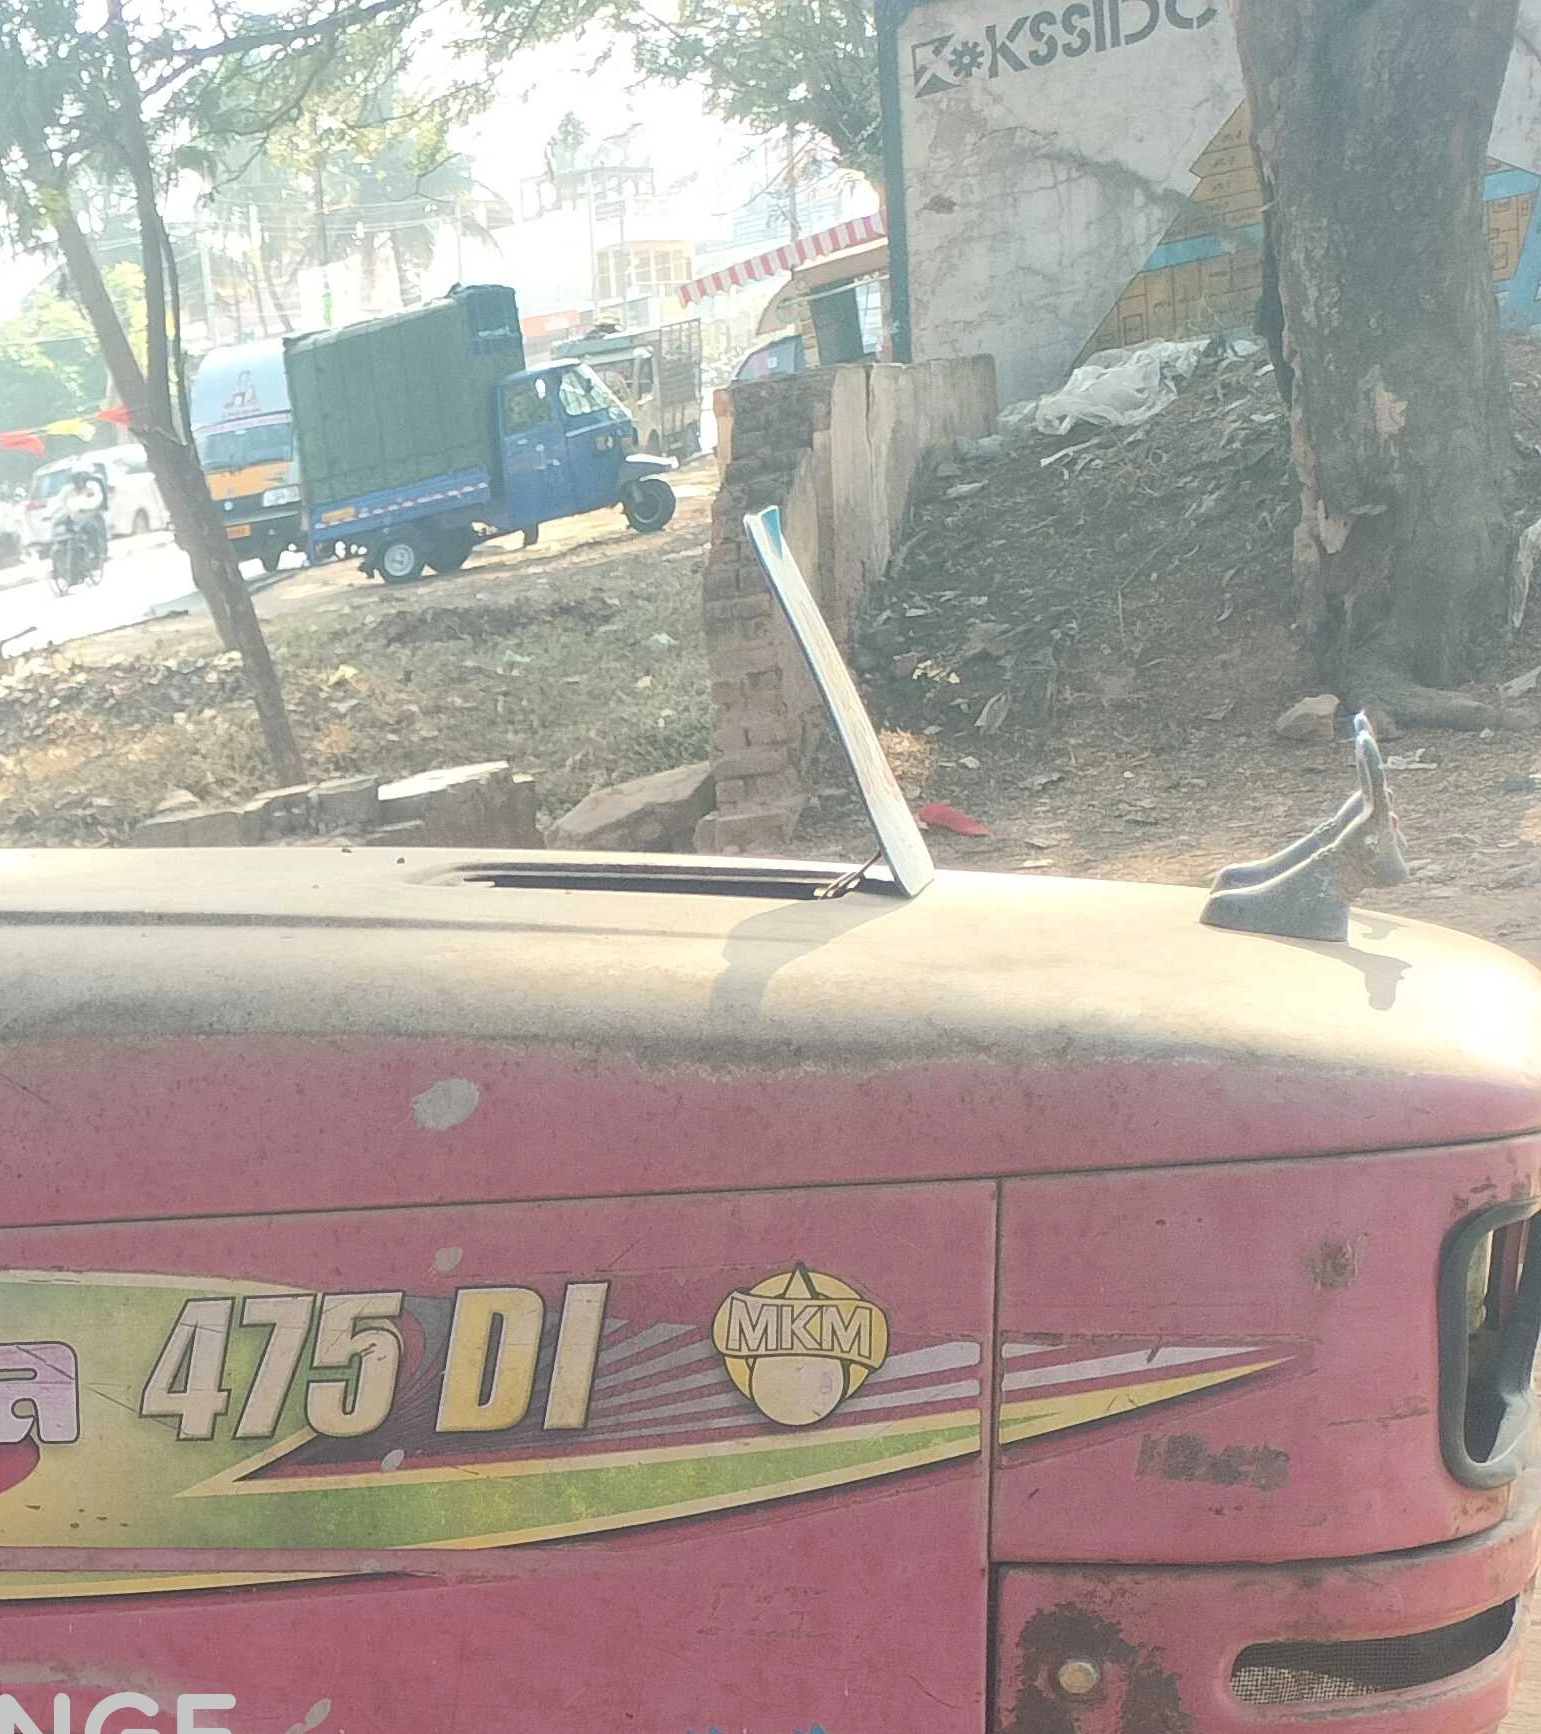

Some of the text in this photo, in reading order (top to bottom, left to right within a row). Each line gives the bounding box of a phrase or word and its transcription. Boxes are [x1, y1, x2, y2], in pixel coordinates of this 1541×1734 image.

[138, 1289, 405, 1442] 475
[434, 1280, 612, 1433] DI
[725, 1296, 873, 1360] MKM
